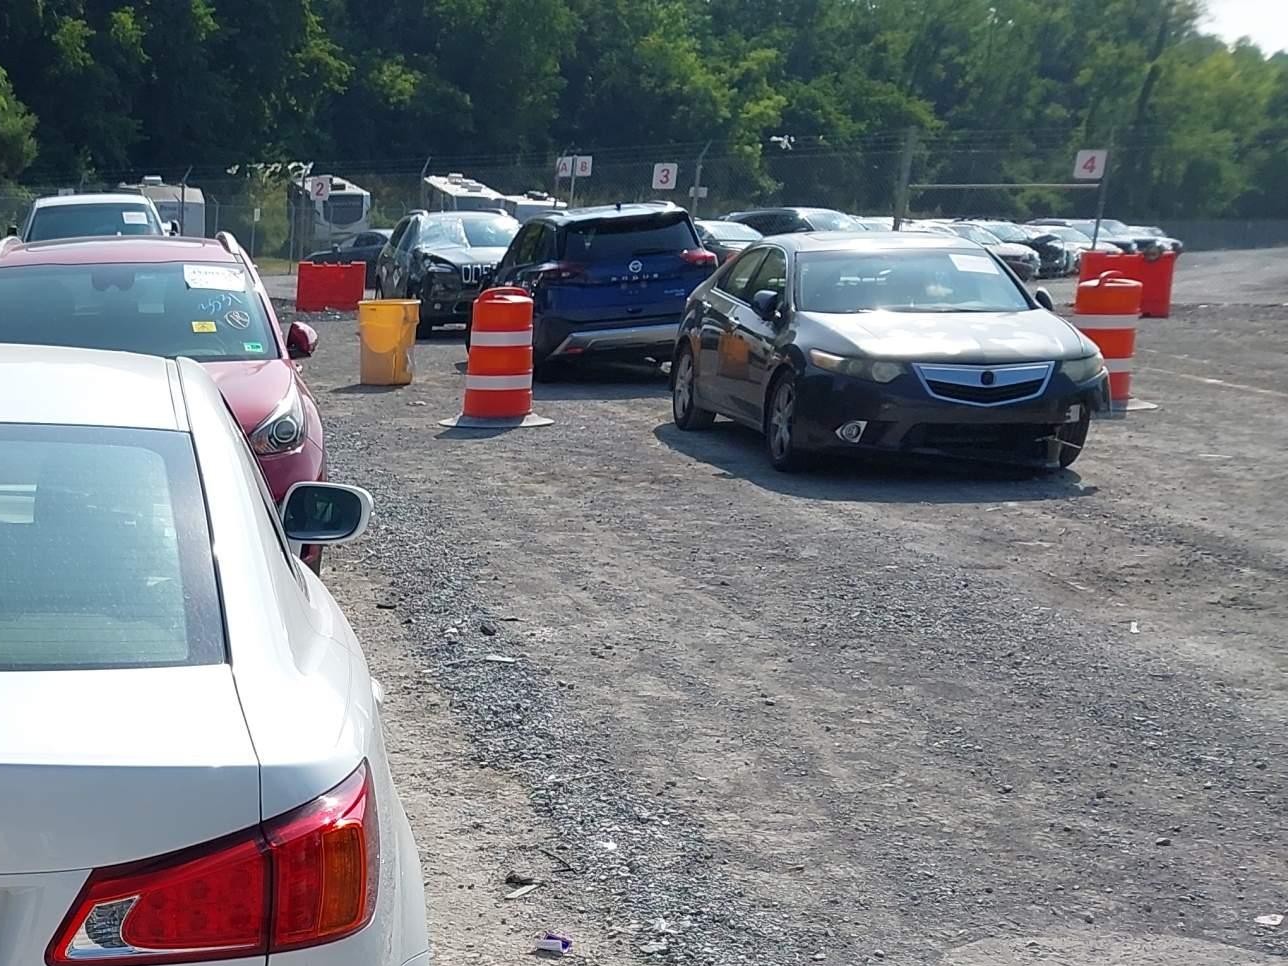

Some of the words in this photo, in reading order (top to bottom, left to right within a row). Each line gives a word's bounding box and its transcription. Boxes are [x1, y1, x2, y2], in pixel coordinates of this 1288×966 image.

[1082, 155, 1097, 174] 4
[659, 168, 670, 185] 3
[315, 181, 325, 197] 2
